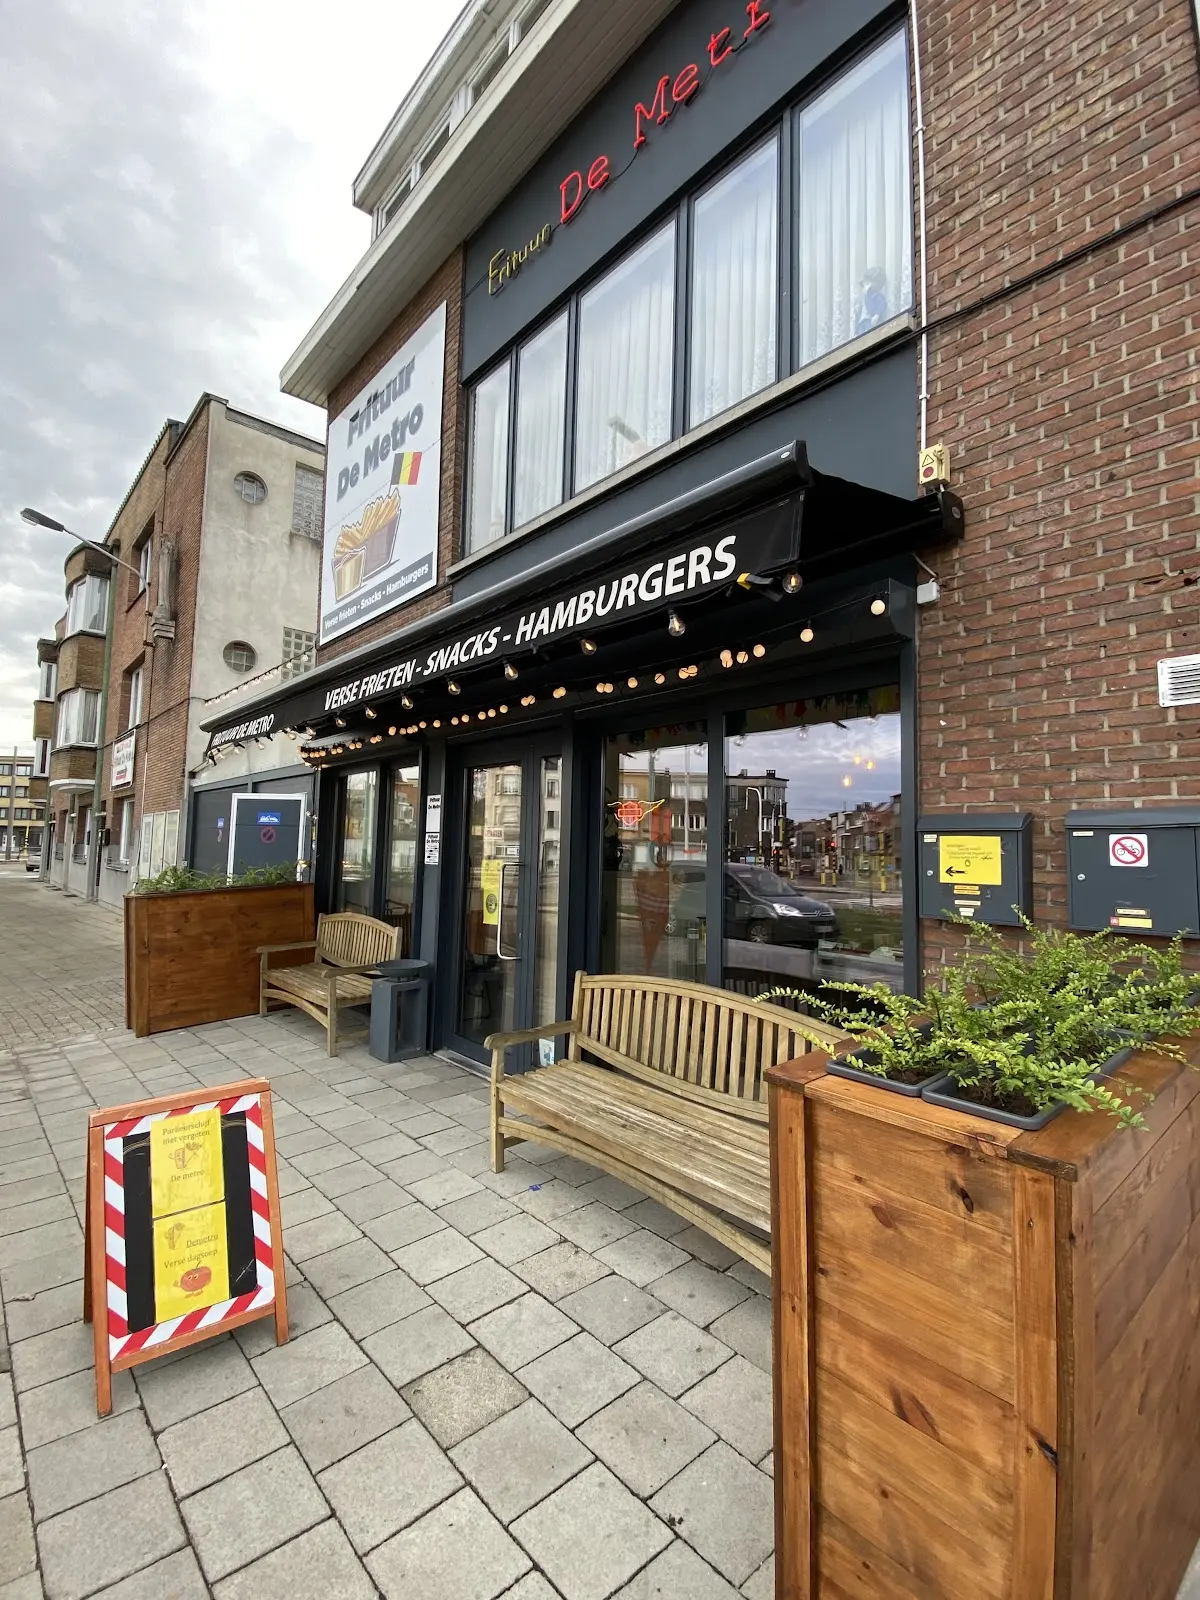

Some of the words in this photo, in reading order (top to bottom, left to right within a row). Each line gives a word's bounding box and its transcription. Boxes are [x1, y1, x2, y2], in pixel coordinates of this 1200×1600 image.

[488, 224, 551, 294] Frituur
[560, 156, 610, 224] De
[347, 355, 415, 449] Frituur
[336, 462, 360, 502] De
[363, 402, 424, 479] Metro
[360, 591, 382, 610] Snacks
[386, 563, 429, 595] Hamburgers
[324, 680, 359, 711] VERSE
[358, 659, 417, 699] FRIETEN
[423, 626, 501, 676] SNACKS
[515, 535, 737, 645] HAMBURGERS
[236, 722, 249, 739] DE
[246, 713, 275, 736] METRO
[178, 1129, 211, 1141] vergeten
[170, 1174, 181, 1182] De
[182, 1169, 205, 1180] metro
[164, 1258, 186, 1269] Verse
[187, 1249, 218, 1262] dagsoep
